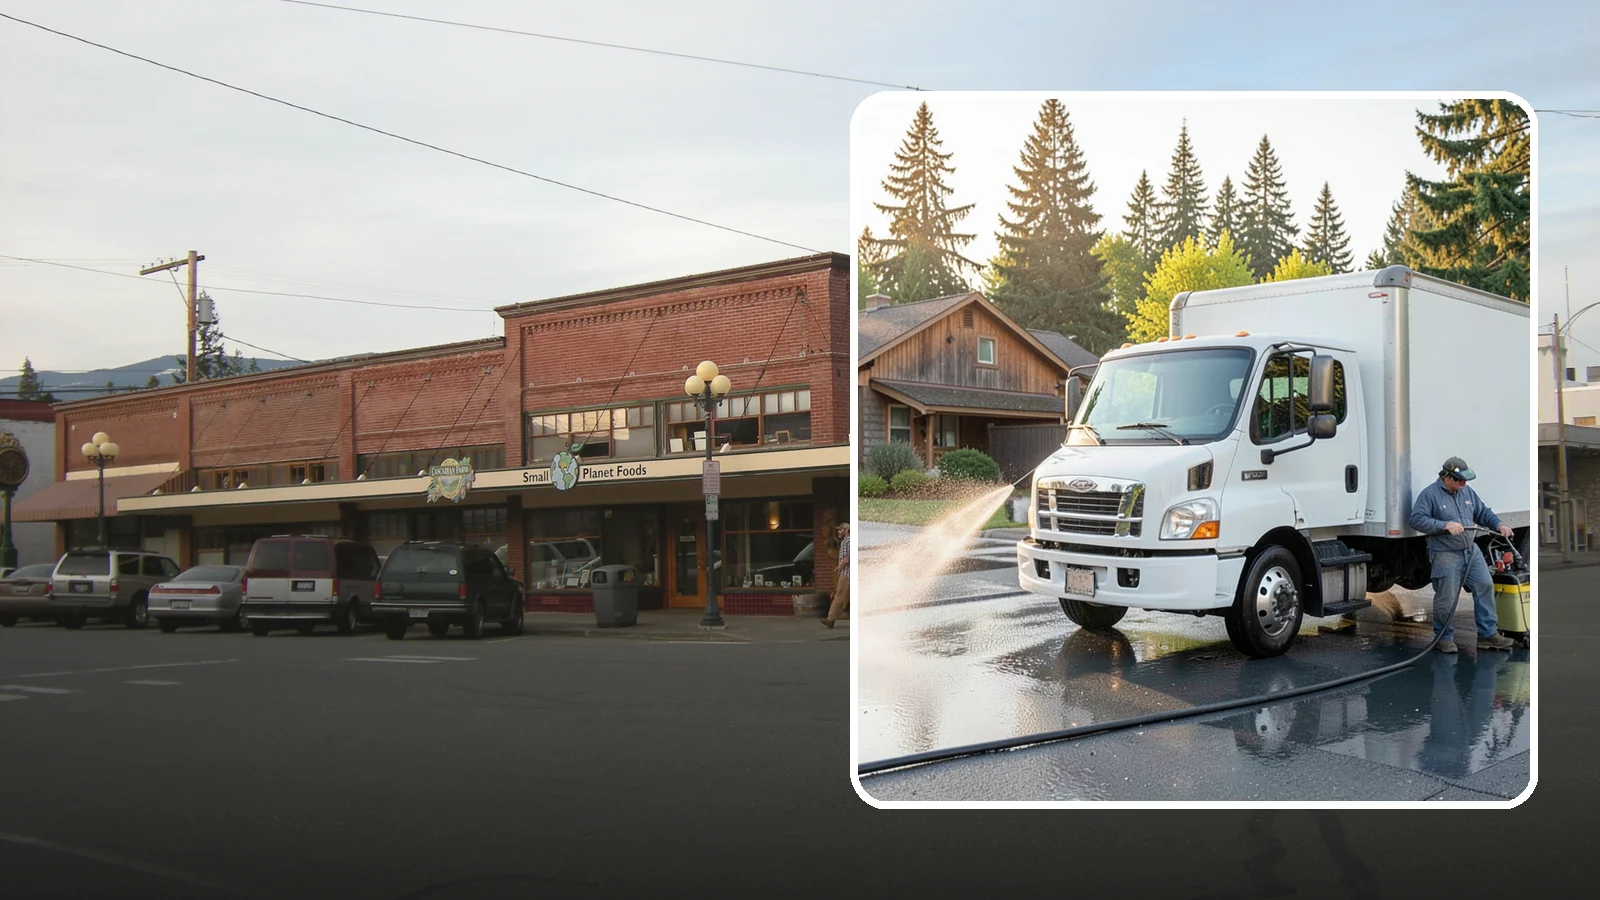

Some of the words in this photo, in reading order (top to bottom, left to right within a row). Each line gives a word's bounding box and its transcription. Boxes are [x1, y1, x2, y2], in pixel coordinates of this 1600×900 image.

[523, 471, 549, 483] Small
[583, 467, 614, 479] Planet
[617, 464, 647, 477] Foods
